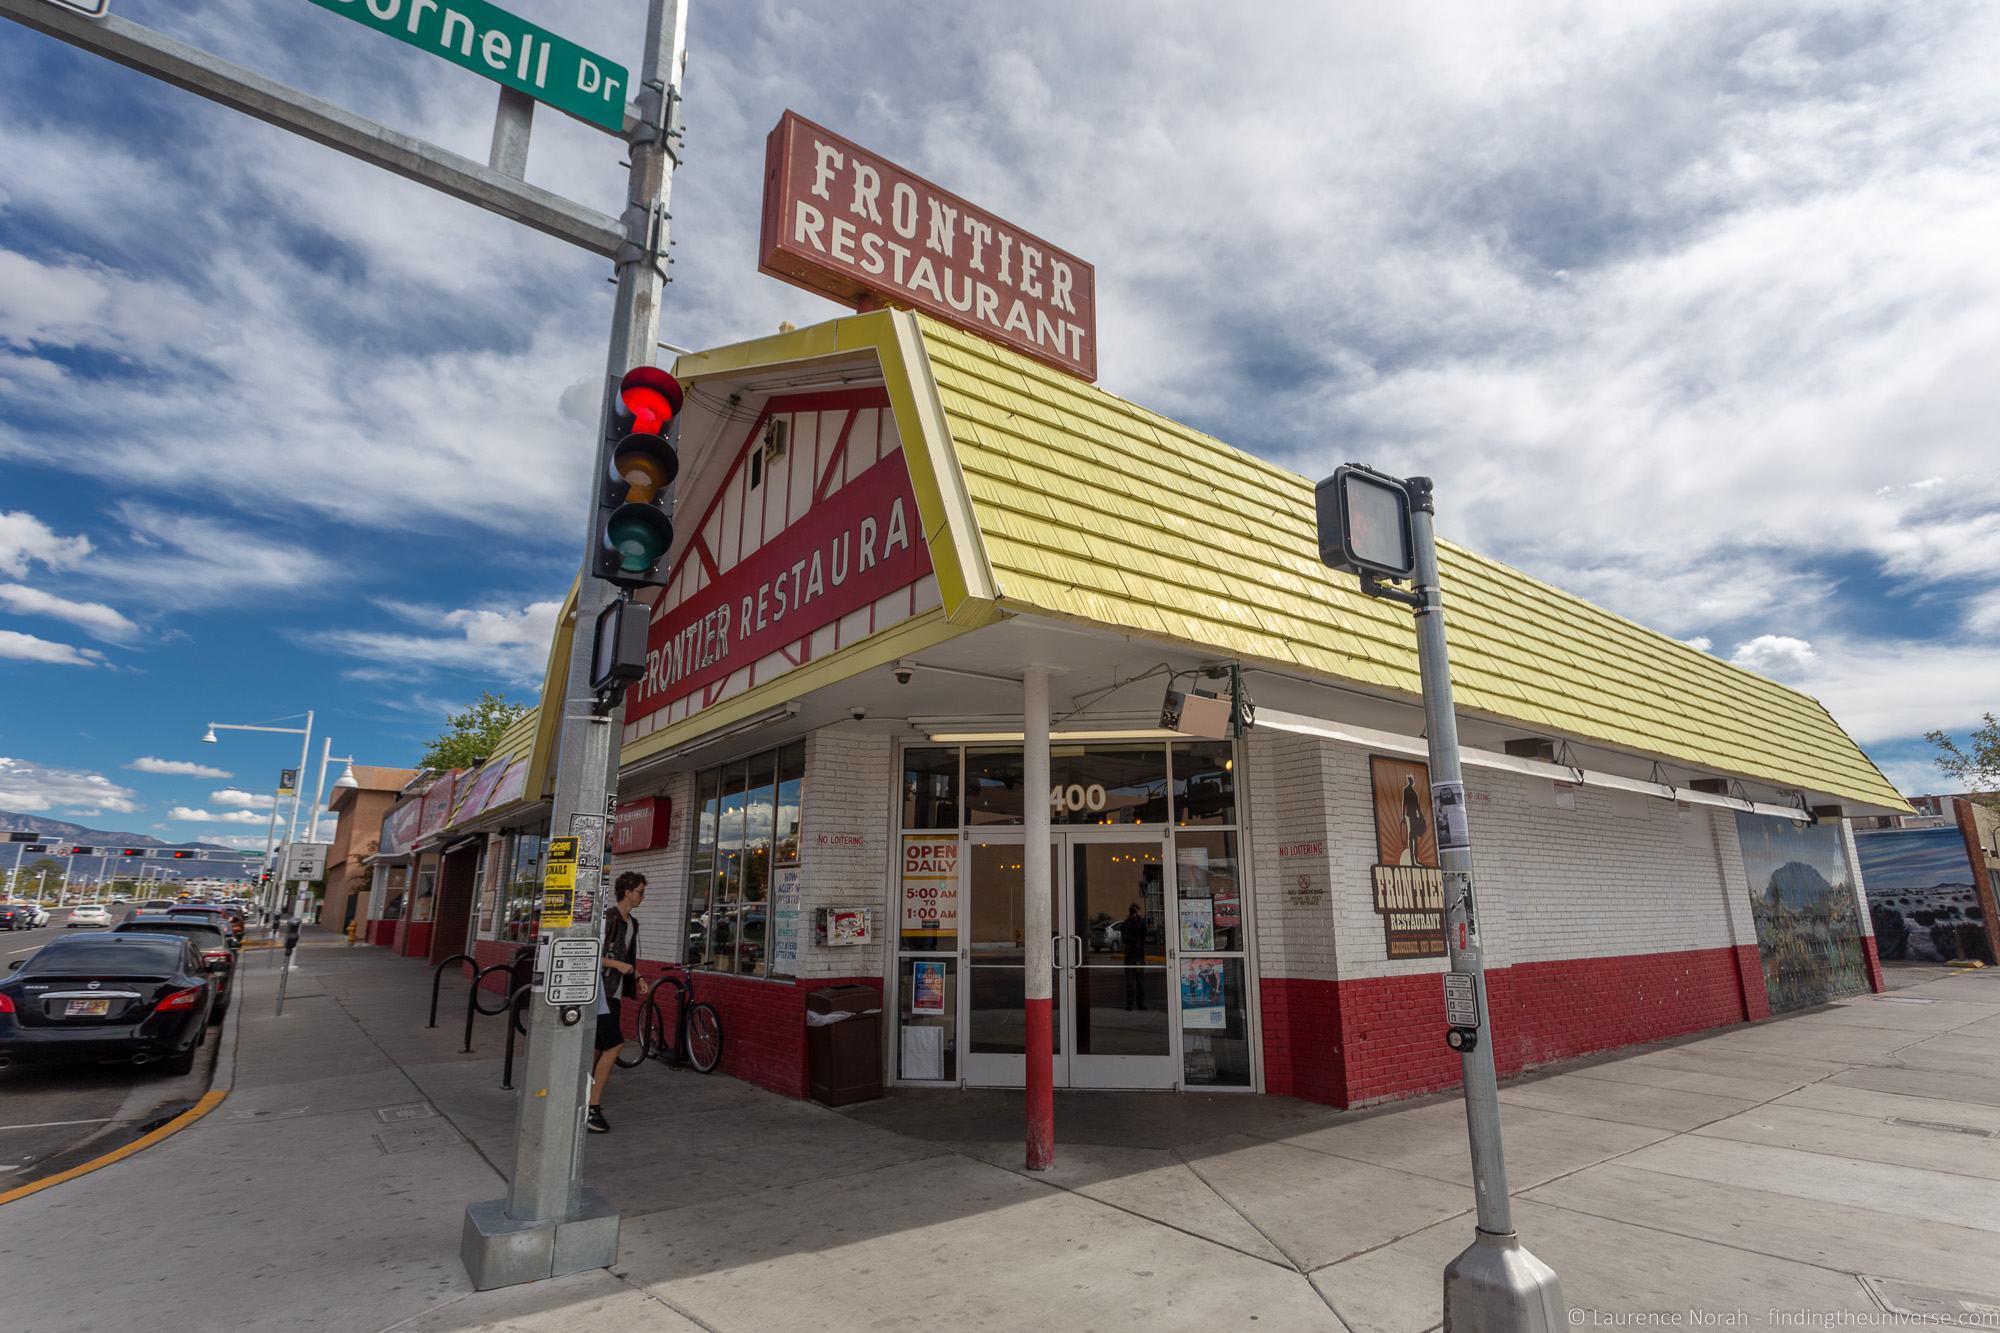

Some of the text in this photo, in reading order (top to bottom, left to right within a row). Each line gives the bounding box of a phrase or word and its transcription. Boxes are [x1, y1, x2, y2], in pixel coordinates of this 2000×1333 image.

[577, 56, 621, 102] Dr
[811, 139, 1076, 315] FRONTIER
[794, 199, 1085, 362] RESTAURANT
[817, 835, 865, 846] NO LOITERING
[906, 845, 958, 859] OPEN
[1279, 842, 1323, 857] NO LOITERING
[906, 860, 957, 873] DAILY
[906, 888, 957, 899] 5:00 AM
[1375, 866, 1444, 909] FRONTIER
[923, 899, 936, 907] TO
[907, 907, 957, 919] 1:00 AM
[1390, 913, 1441, 931] RESTAURANT
